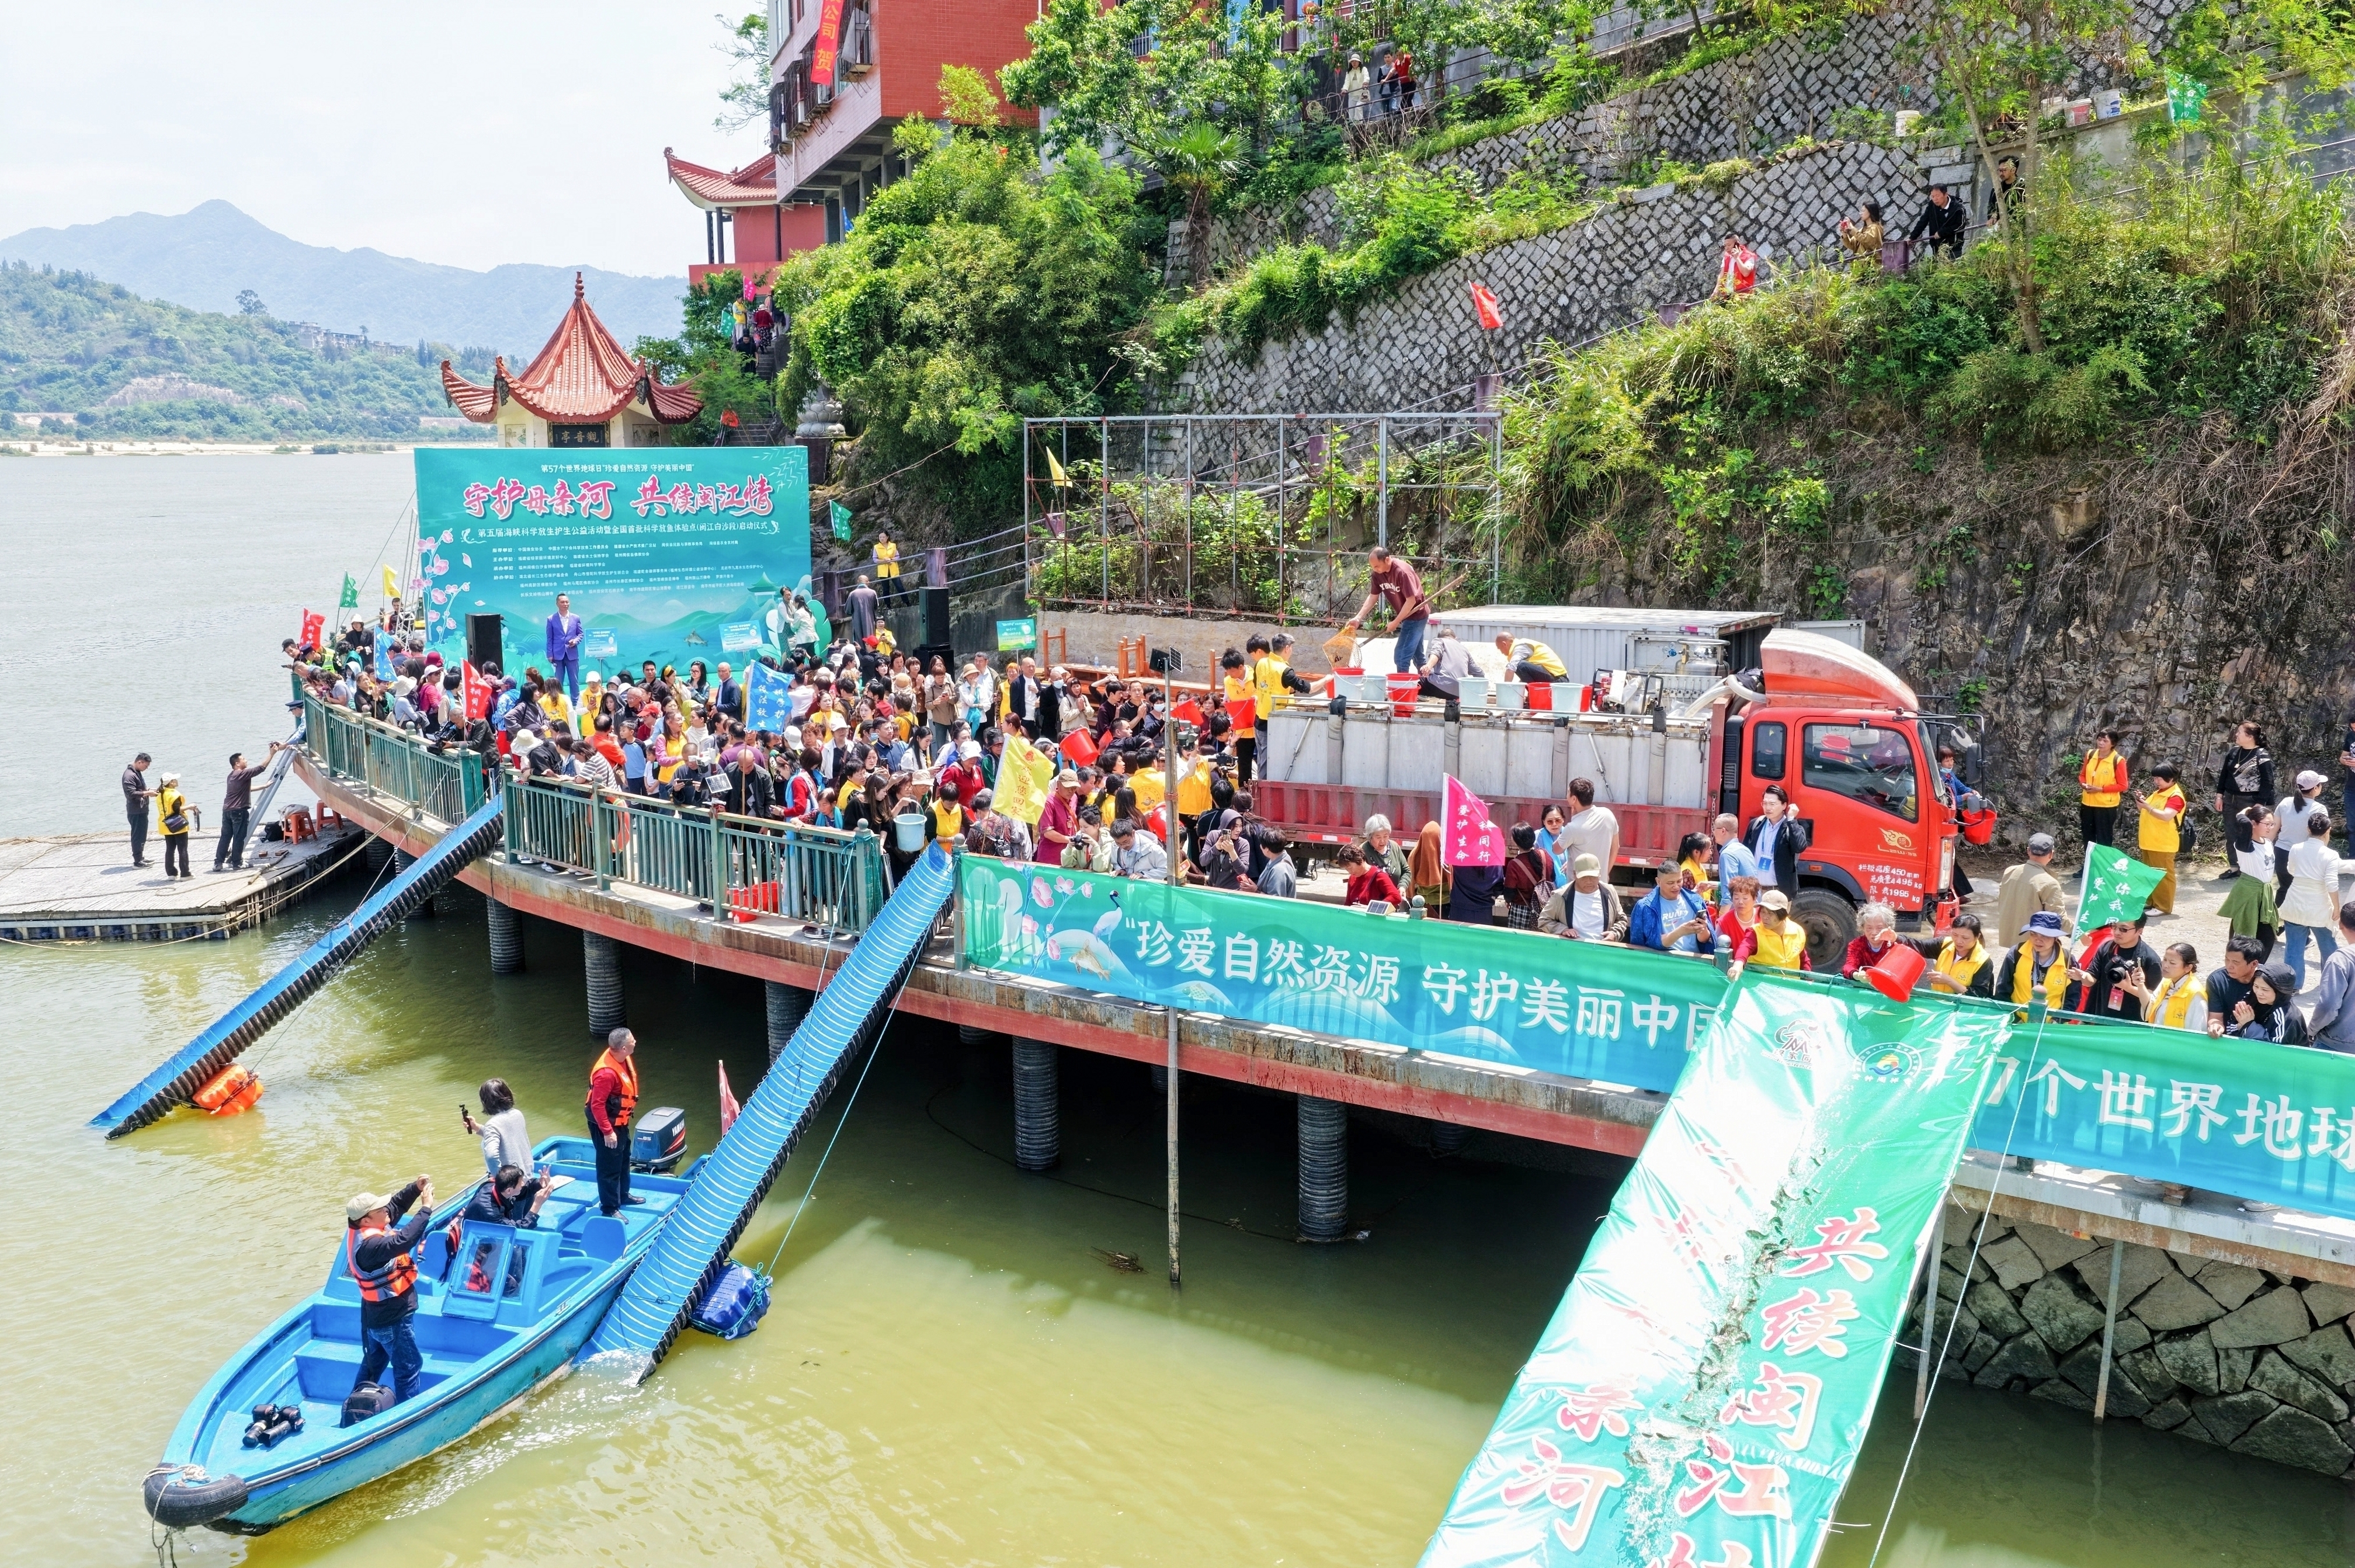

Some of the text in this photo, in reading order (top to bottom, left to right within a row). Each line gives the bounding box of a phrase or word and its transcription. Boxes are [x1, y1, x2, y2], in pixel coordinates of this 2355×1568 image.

[815, 0, 842, 72] 公司 贺
[463, 474, 774, 520] 守护母亲河 共续闽江情
[756, 684, 769, 728] 依法放生
[1010, 766, 1033, 816] 欢迎您回家
[1455, 805, 1470, 863] 爱护生命
[1125, 916, 1401, 1004] “珍爱自然资源
